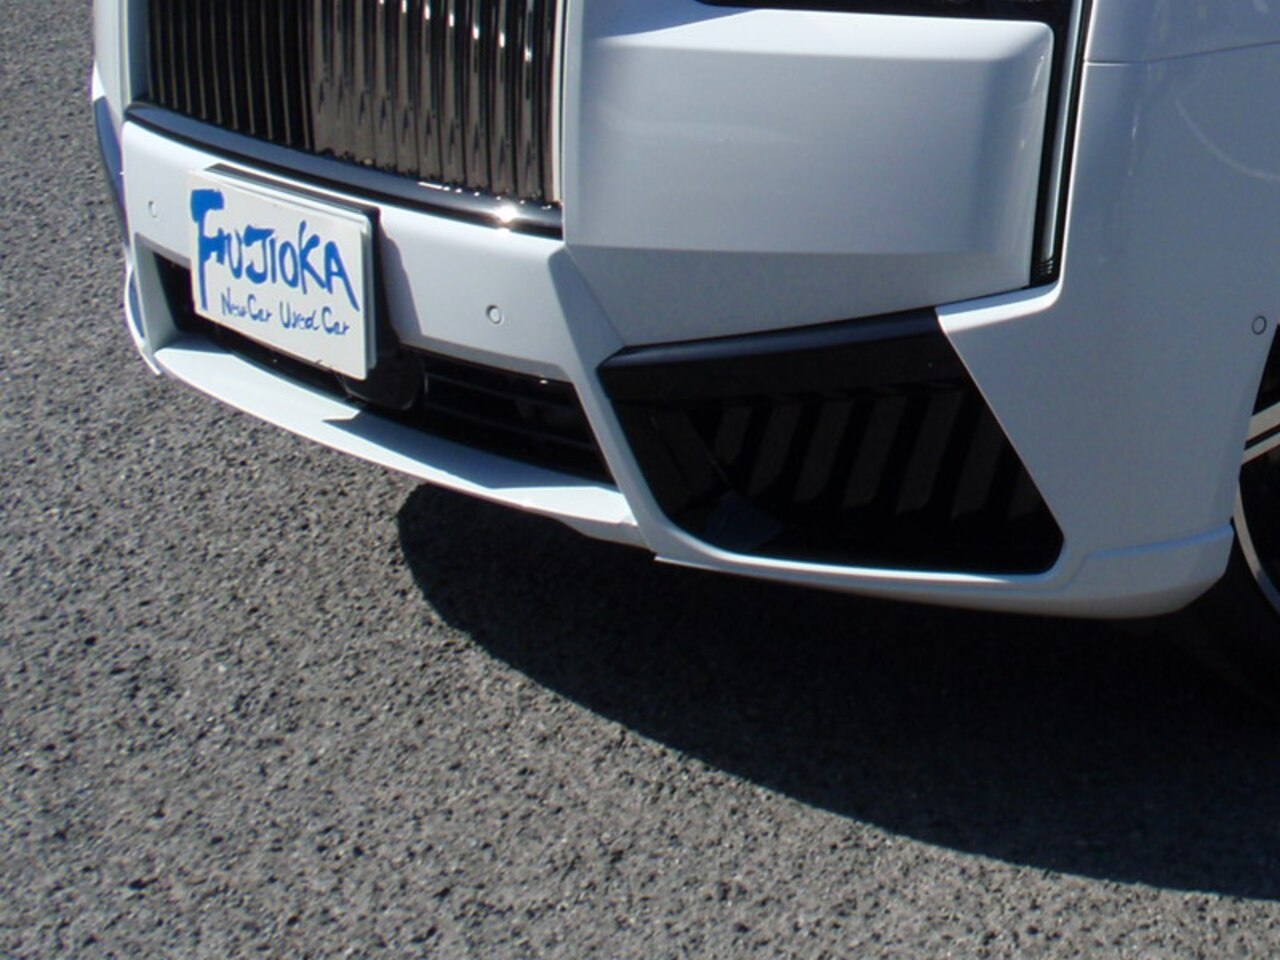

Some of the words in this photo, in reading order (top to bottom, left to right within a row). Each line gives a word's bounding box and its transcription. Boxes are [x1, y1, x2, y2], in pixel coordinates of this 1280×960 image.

[190, 188, 361, 312] FUJIOKA
[247, 293, 273, 322] Car
[321, 306, 350, 335] Car
